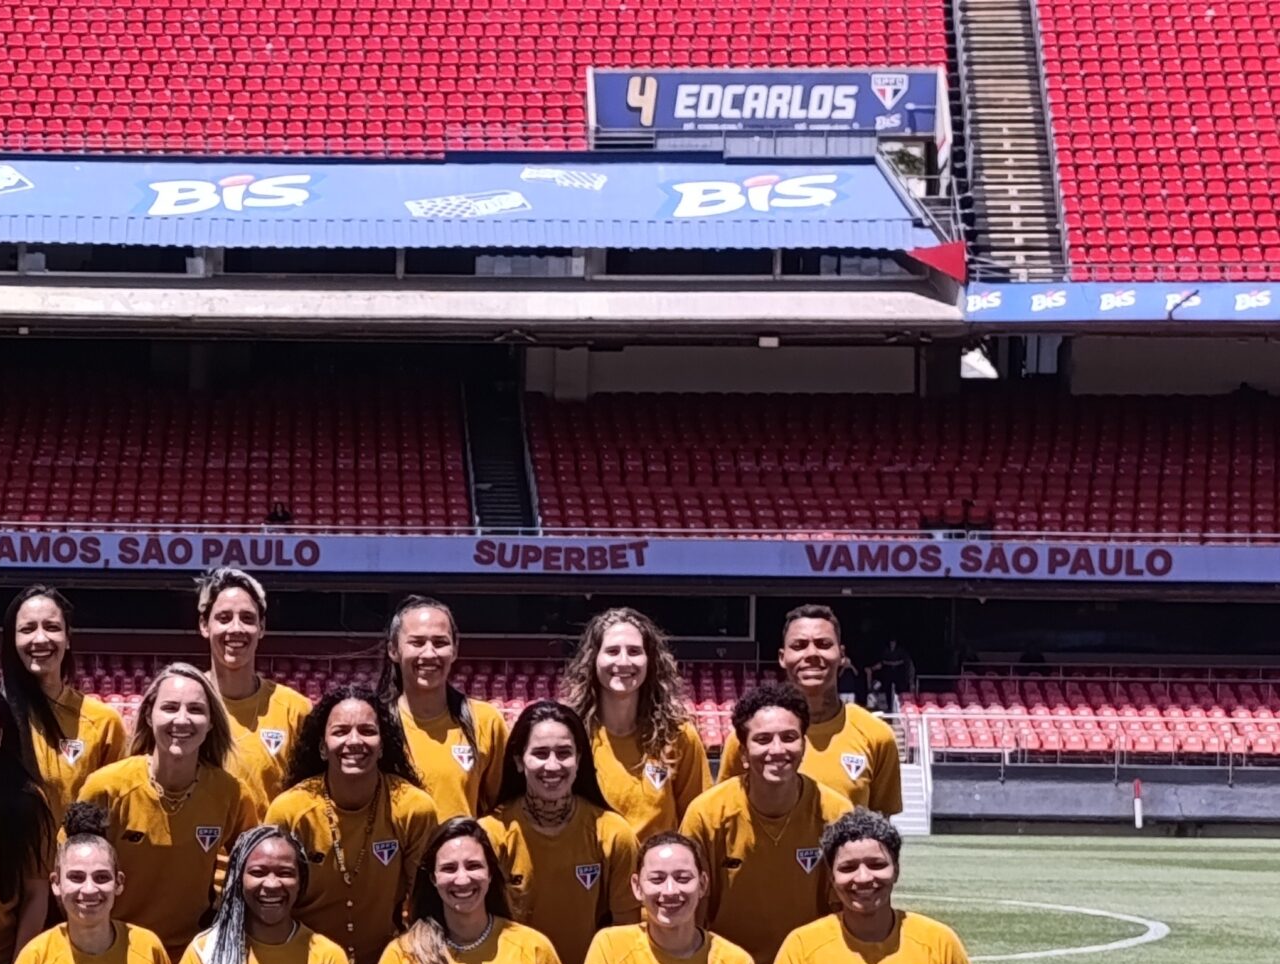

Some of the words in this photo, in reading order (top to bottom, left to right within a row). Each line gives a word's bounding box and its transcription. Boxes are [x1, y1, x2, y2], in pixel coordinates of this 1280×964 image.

[627, 76, 658, 127] 4
[674, 84, 859, 119] EDCARLOS
[117, 535, 193, 565] SÃO
[201, 539, 320, 567] PAULO
[473, 539, 650, 571] SUPERBET
[805, 544, 951, 577] VAMOS,
[959, 544, 1039, 574] SÃO
[1048, 547, 1173, 576] PAULO
